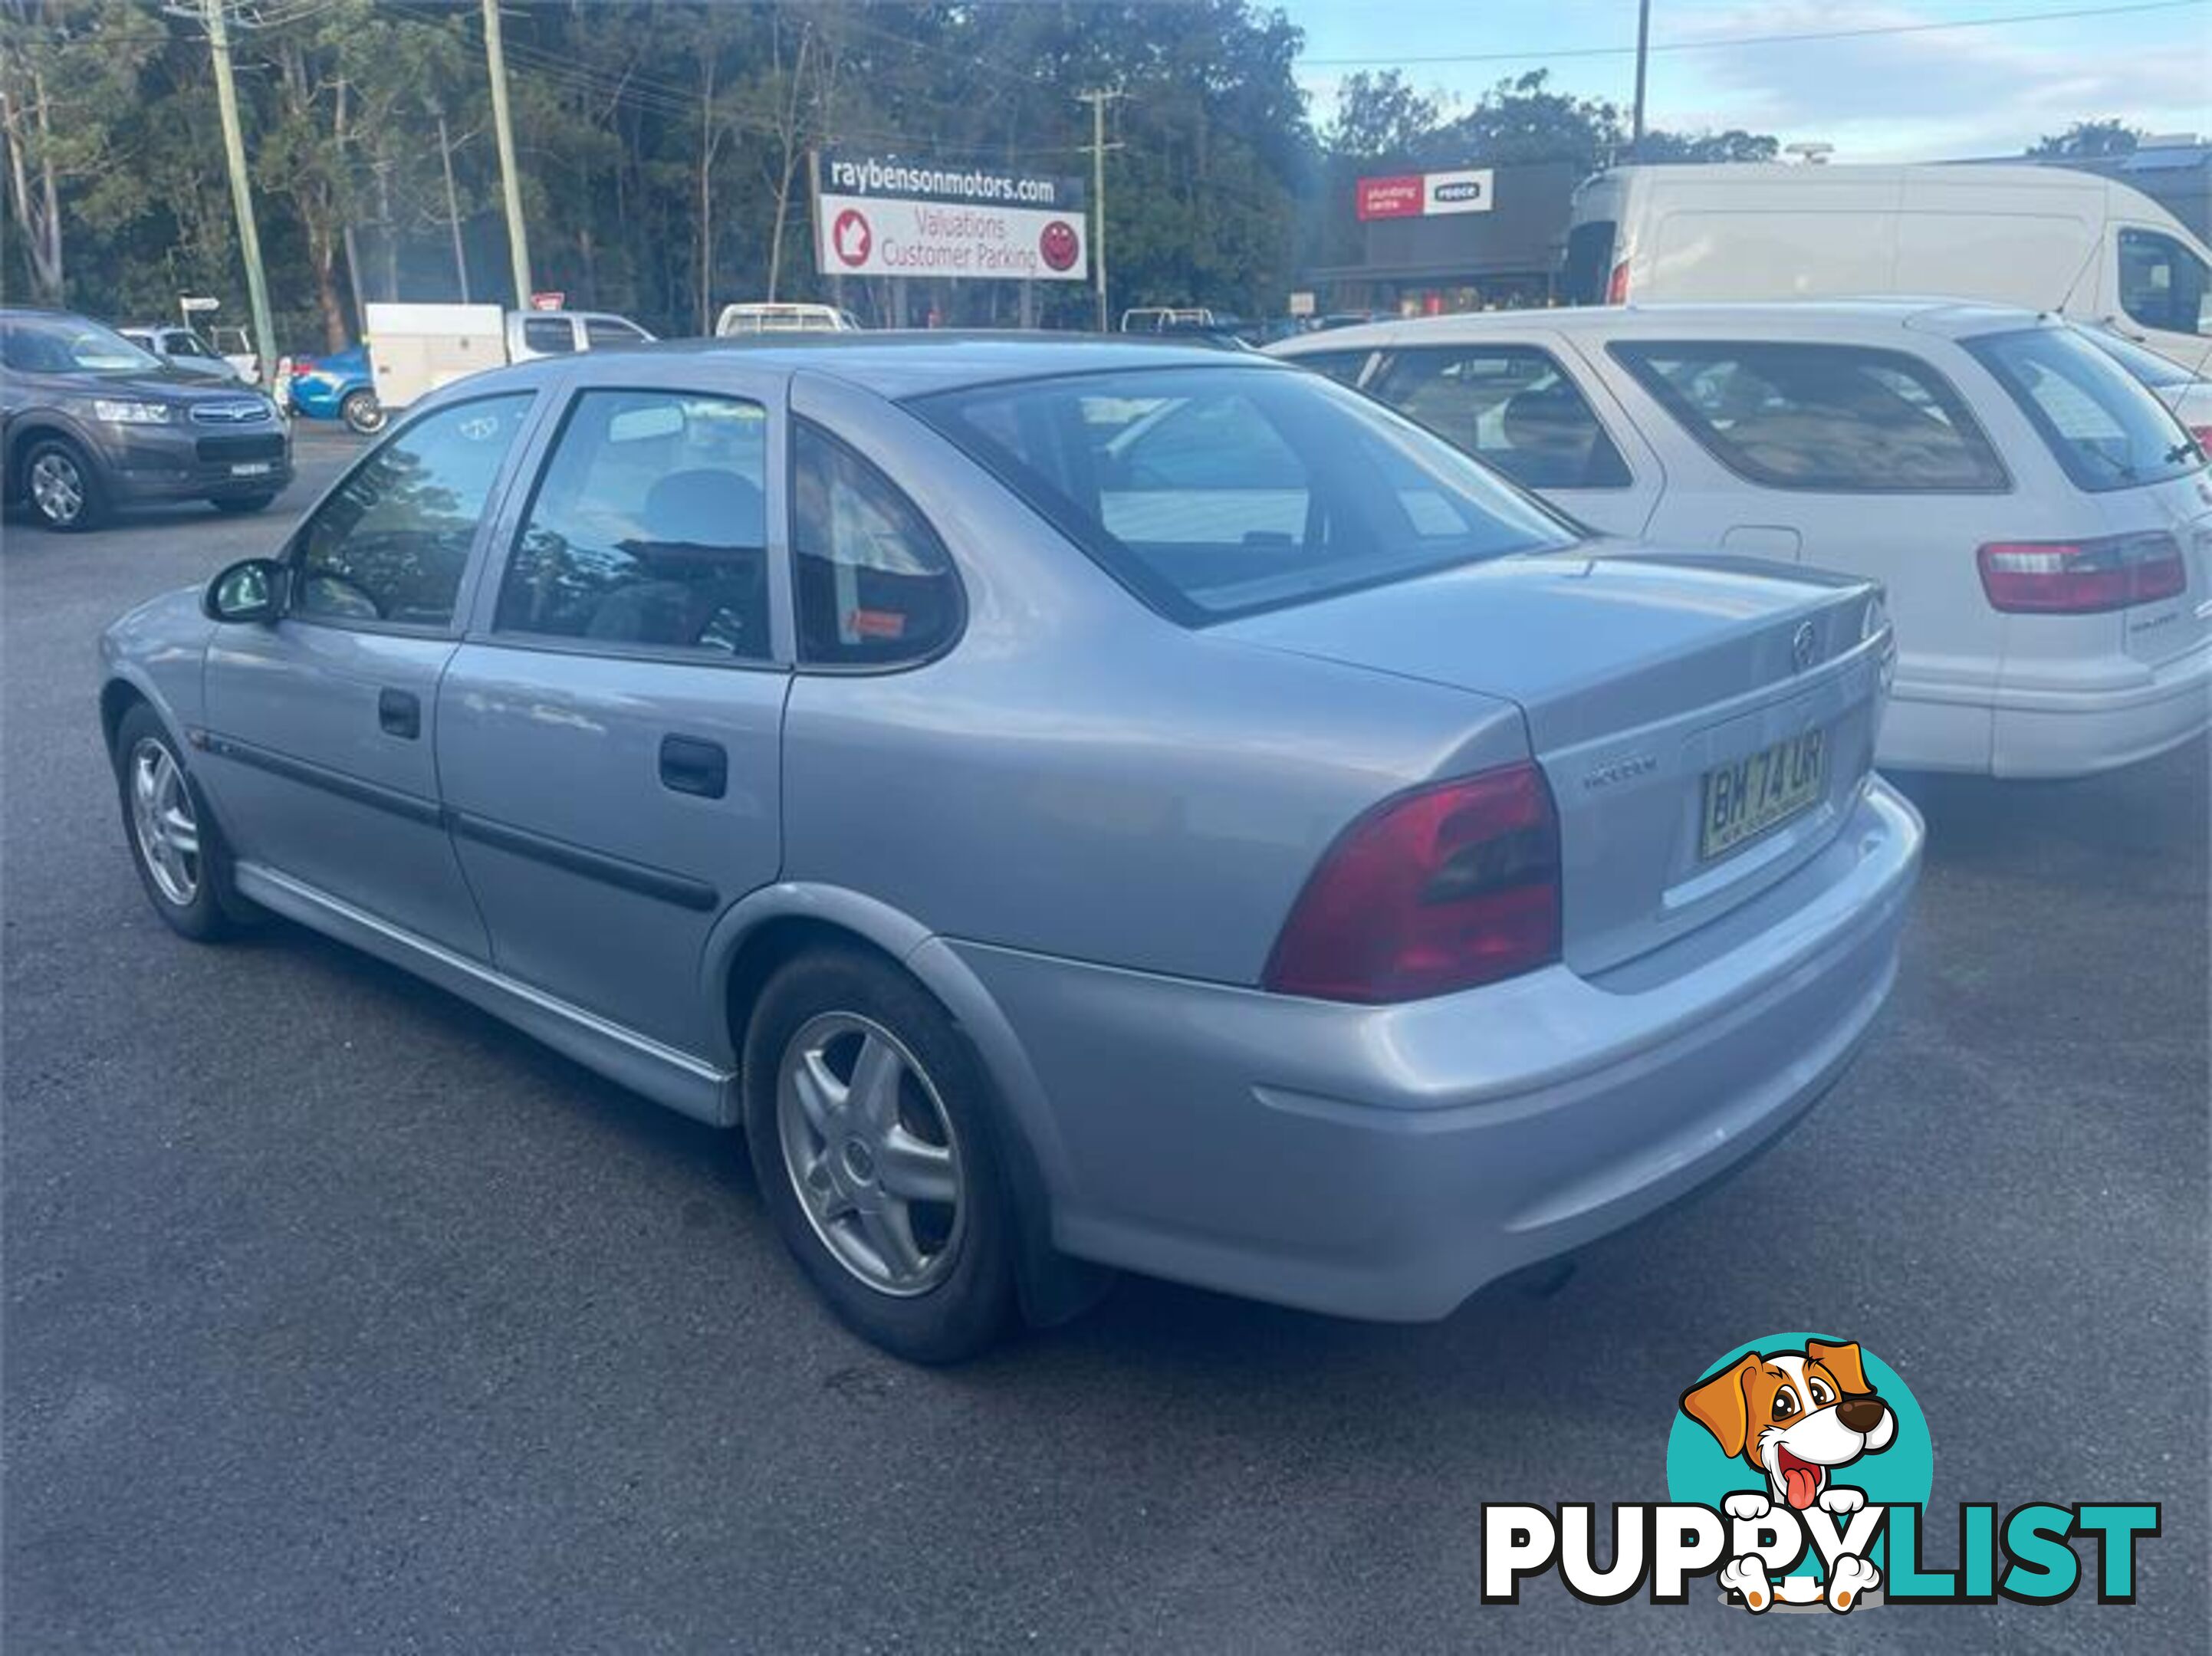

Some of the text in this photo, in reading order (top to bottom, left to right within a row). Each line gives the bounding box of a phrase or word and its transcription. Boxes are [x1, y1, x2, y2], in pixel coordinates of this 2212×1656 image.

[832, 158, 1054, 202] raybensonmotors.com
[914, 206, 1005, 238] Valuations
[882, 238, 1037, 270] Customer Parking
